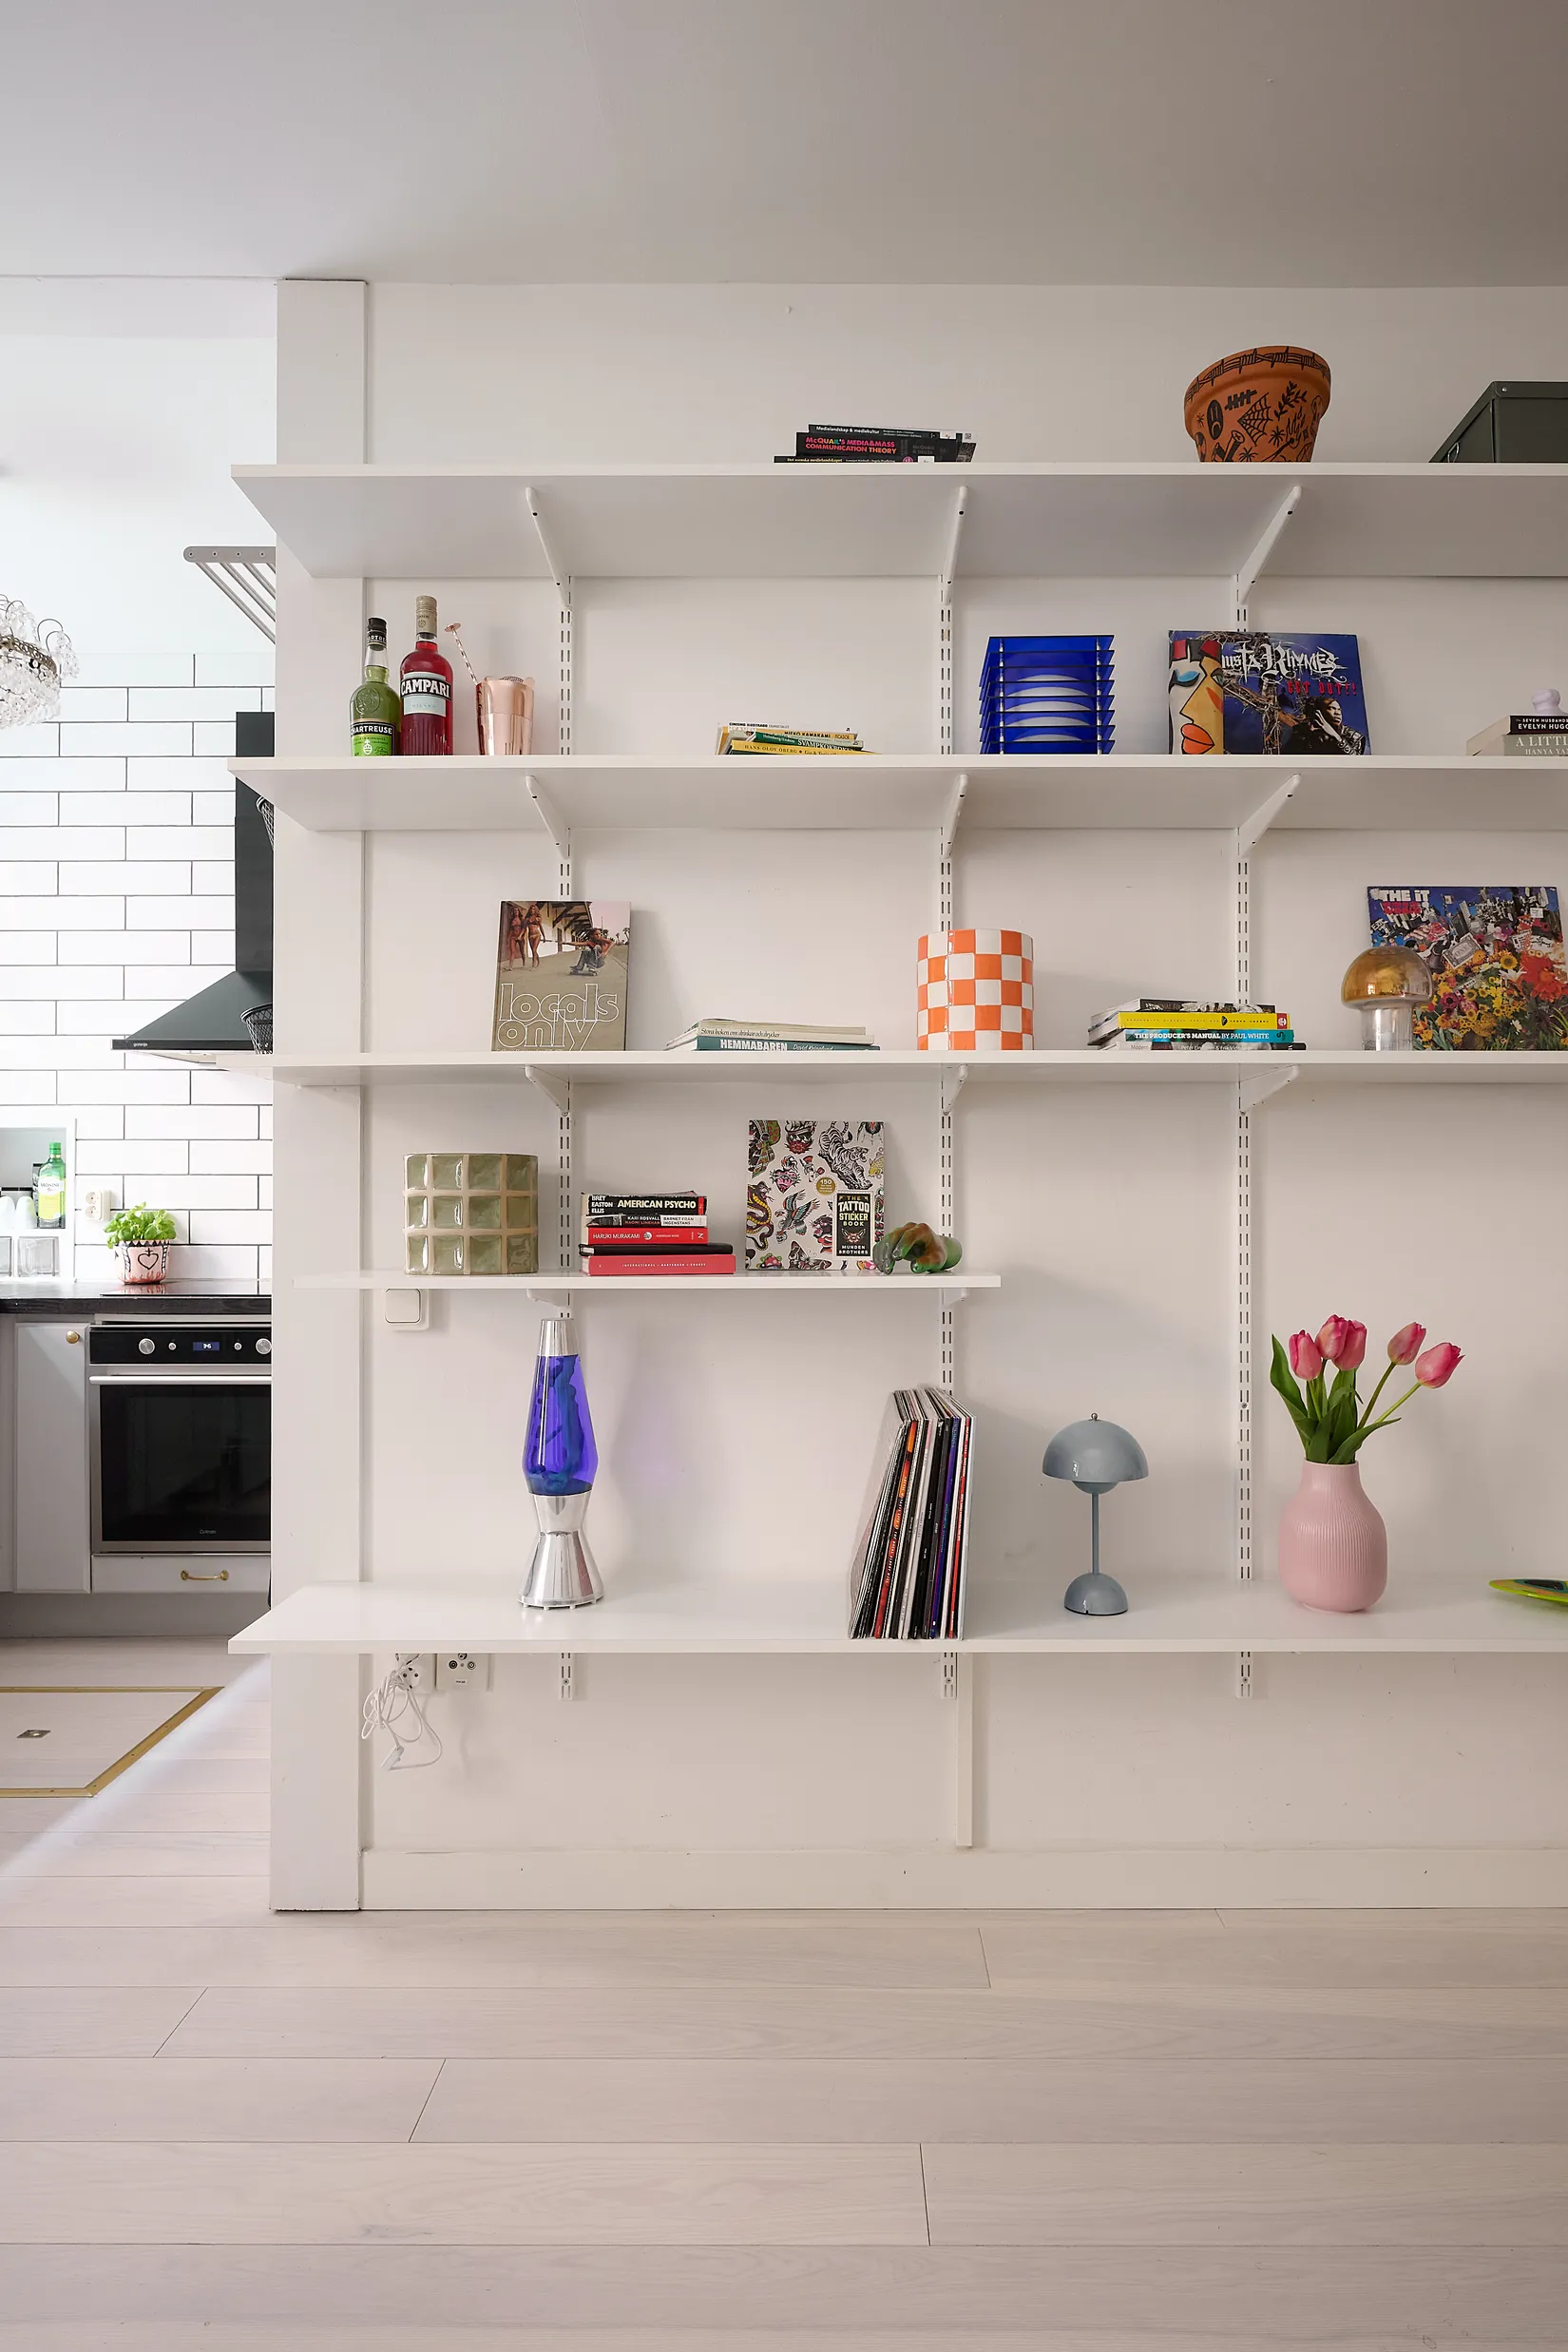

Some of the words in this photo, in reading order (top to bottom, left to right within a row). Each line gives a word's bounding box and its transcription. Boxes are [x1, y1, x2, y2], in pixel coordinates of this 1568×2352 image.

[805, 444, 867, 452] COMMUNICATION
[400, 679, 450, 698] CAMPARI
[1516, 736, 1524, 747] A
[1380, 889, 1411, 902] THE
[499, 984, 619, 1023] locals
[497, 1009, 598, 1051] only
[720, 1039, 788, 1051] HEMMABAREN
[617, 1199, 663, 1208] AMERICAN
[664, 1200, 697, 1209] PSYCHO
[837, 1201, 870, 1214] TATTOO
[839, 1213, 869, 1221] STICKER
